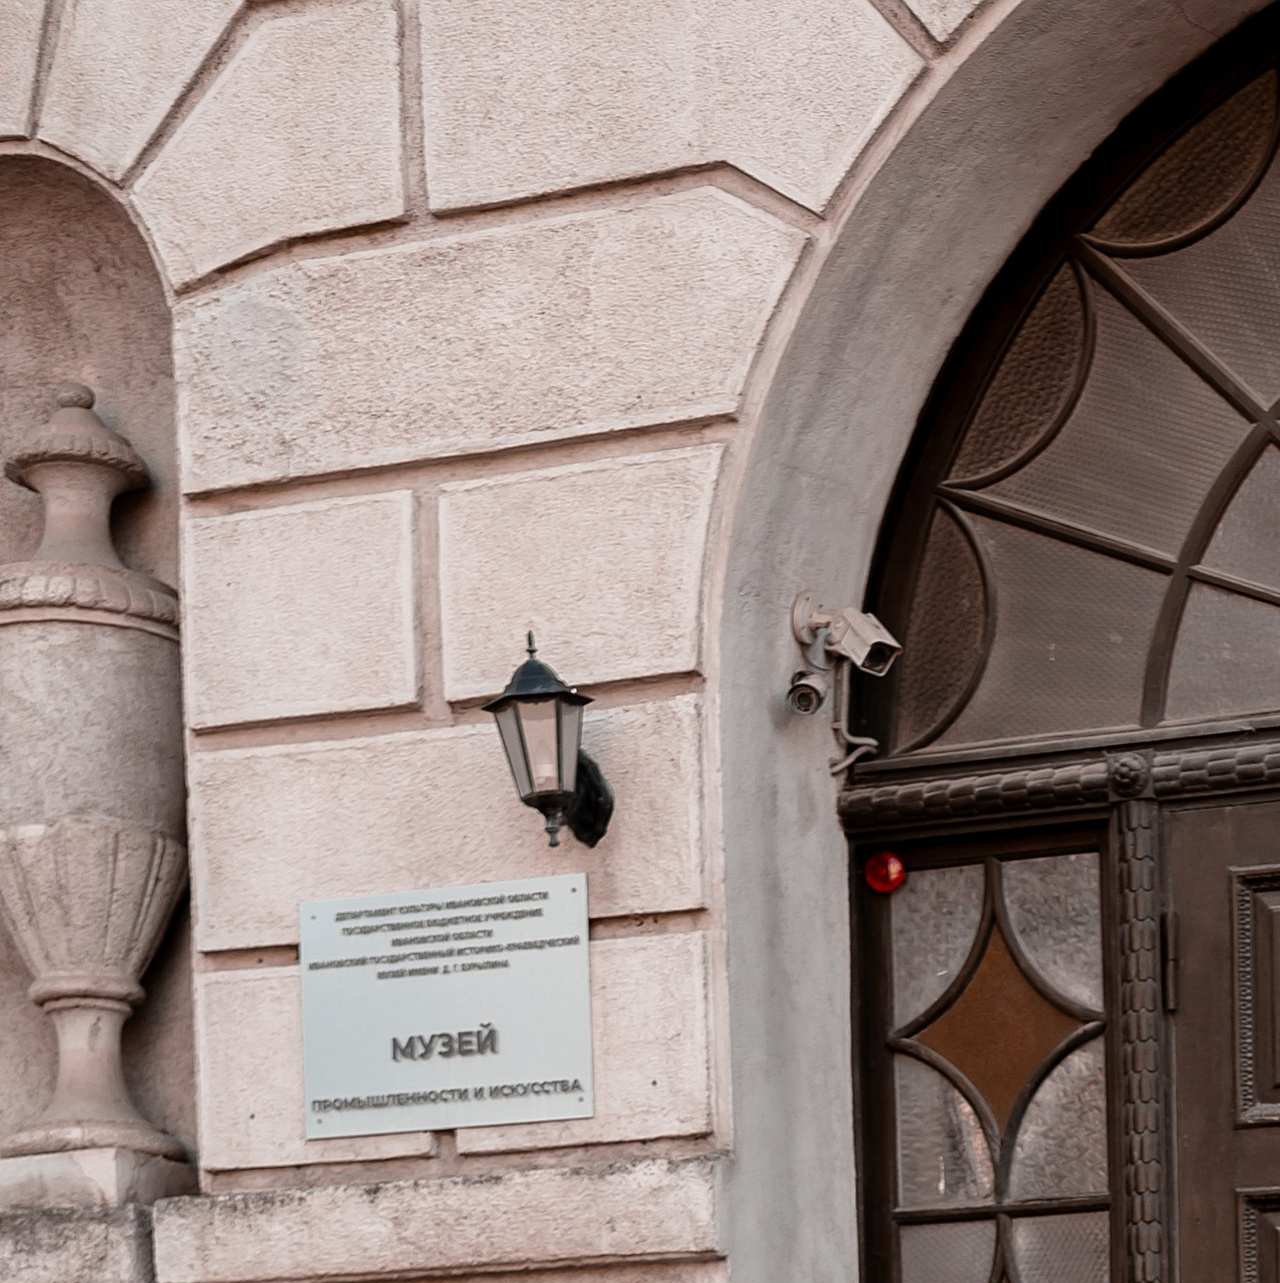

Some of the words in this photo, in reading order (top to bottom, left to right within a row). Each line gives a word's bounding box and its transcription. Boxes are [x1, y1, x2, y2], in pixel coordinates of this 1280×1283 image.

[391, 1022, 499, 1062] МУЗЕЙ
[311, 1087, 470, 1114] ПРОМЫШЛЕННОСТИ
[473, 1086, 485, 1100] И
[489, 1079, 584, 1099] ИСКУССТВА
